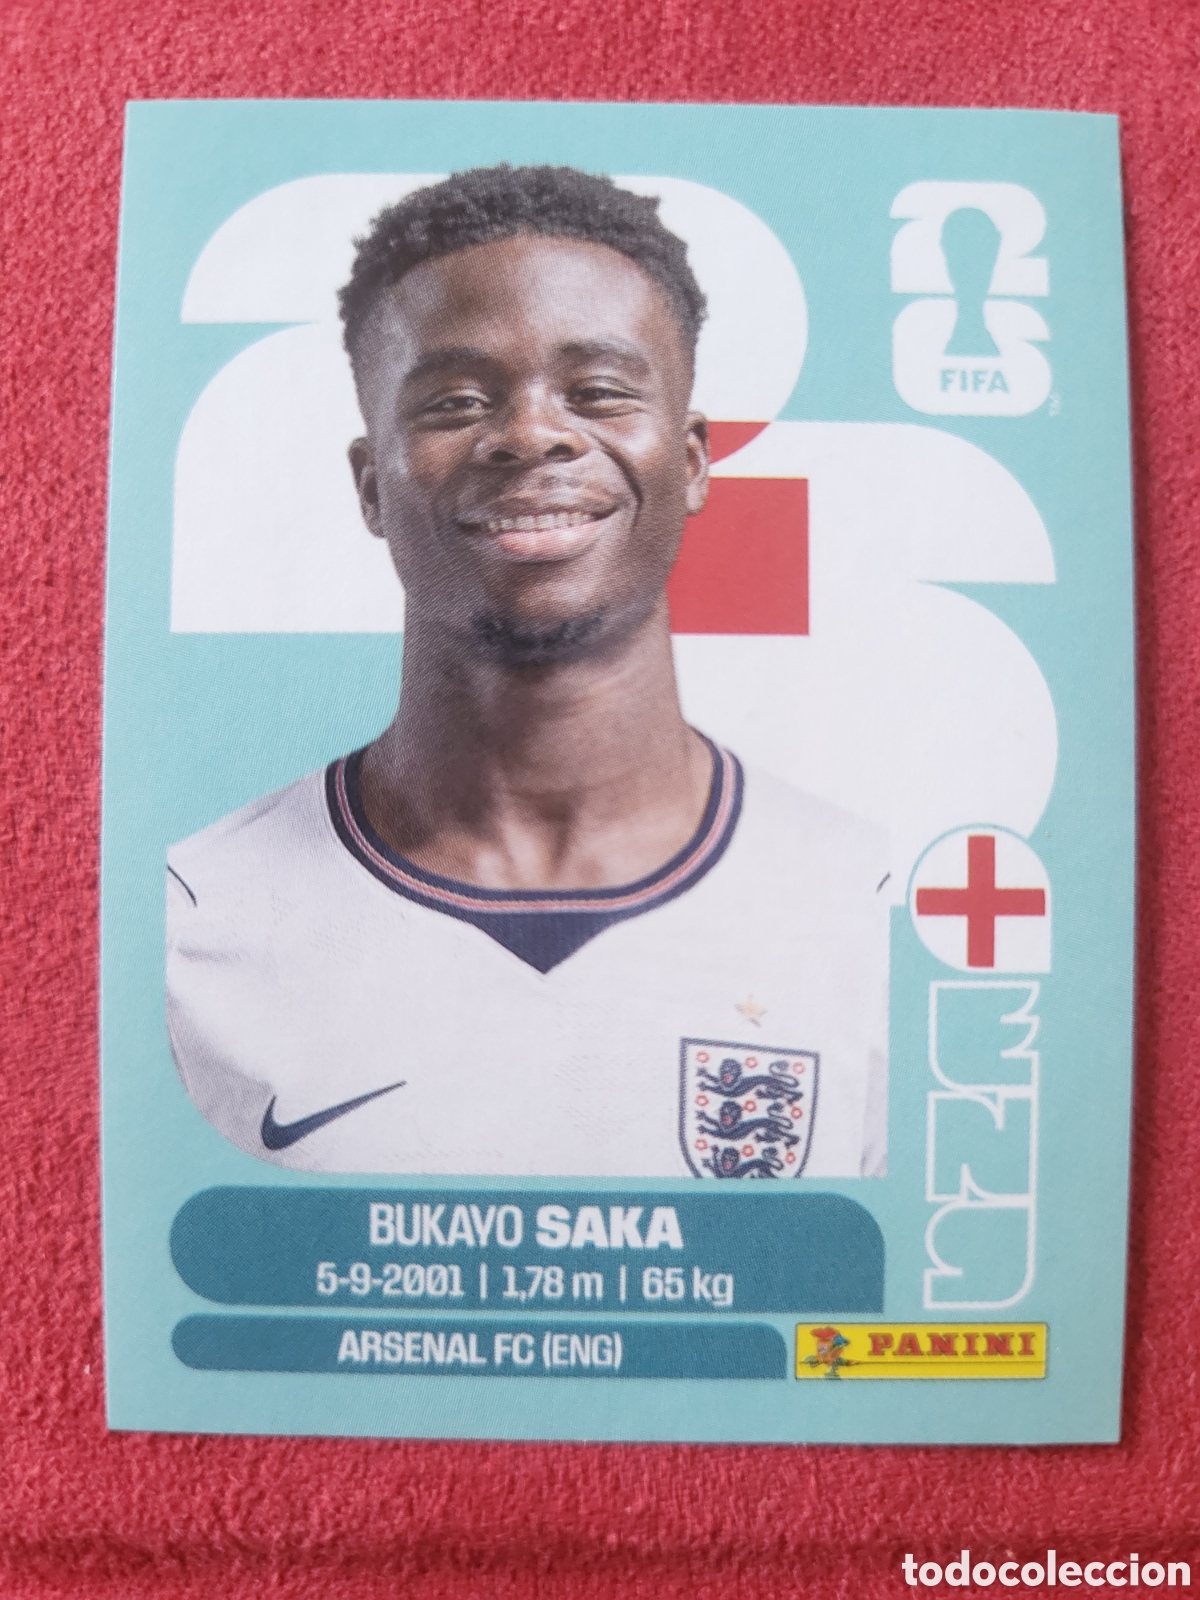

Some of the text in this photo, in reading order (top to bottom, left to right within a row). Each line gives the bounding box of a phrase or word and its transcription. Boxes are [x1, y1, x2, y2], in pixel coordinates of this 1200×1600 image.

[940, 369, 1010, 394] FIFA
[369, 1202, 685, 1250] BUKAYO SAKA
[316, 1262, 465, 1297] 5-9-2001
[502, 1266, 564, 1302] 1,78
[572, 1271, 604, 1300] m
[642, 1267, 686, 1301] 65
[692, 1267, 734, 1307] kg
[337, 1329, 623, 1370] ARSENAL FC (ENG)
[867, 1332, 1036, 1356] PANINI
